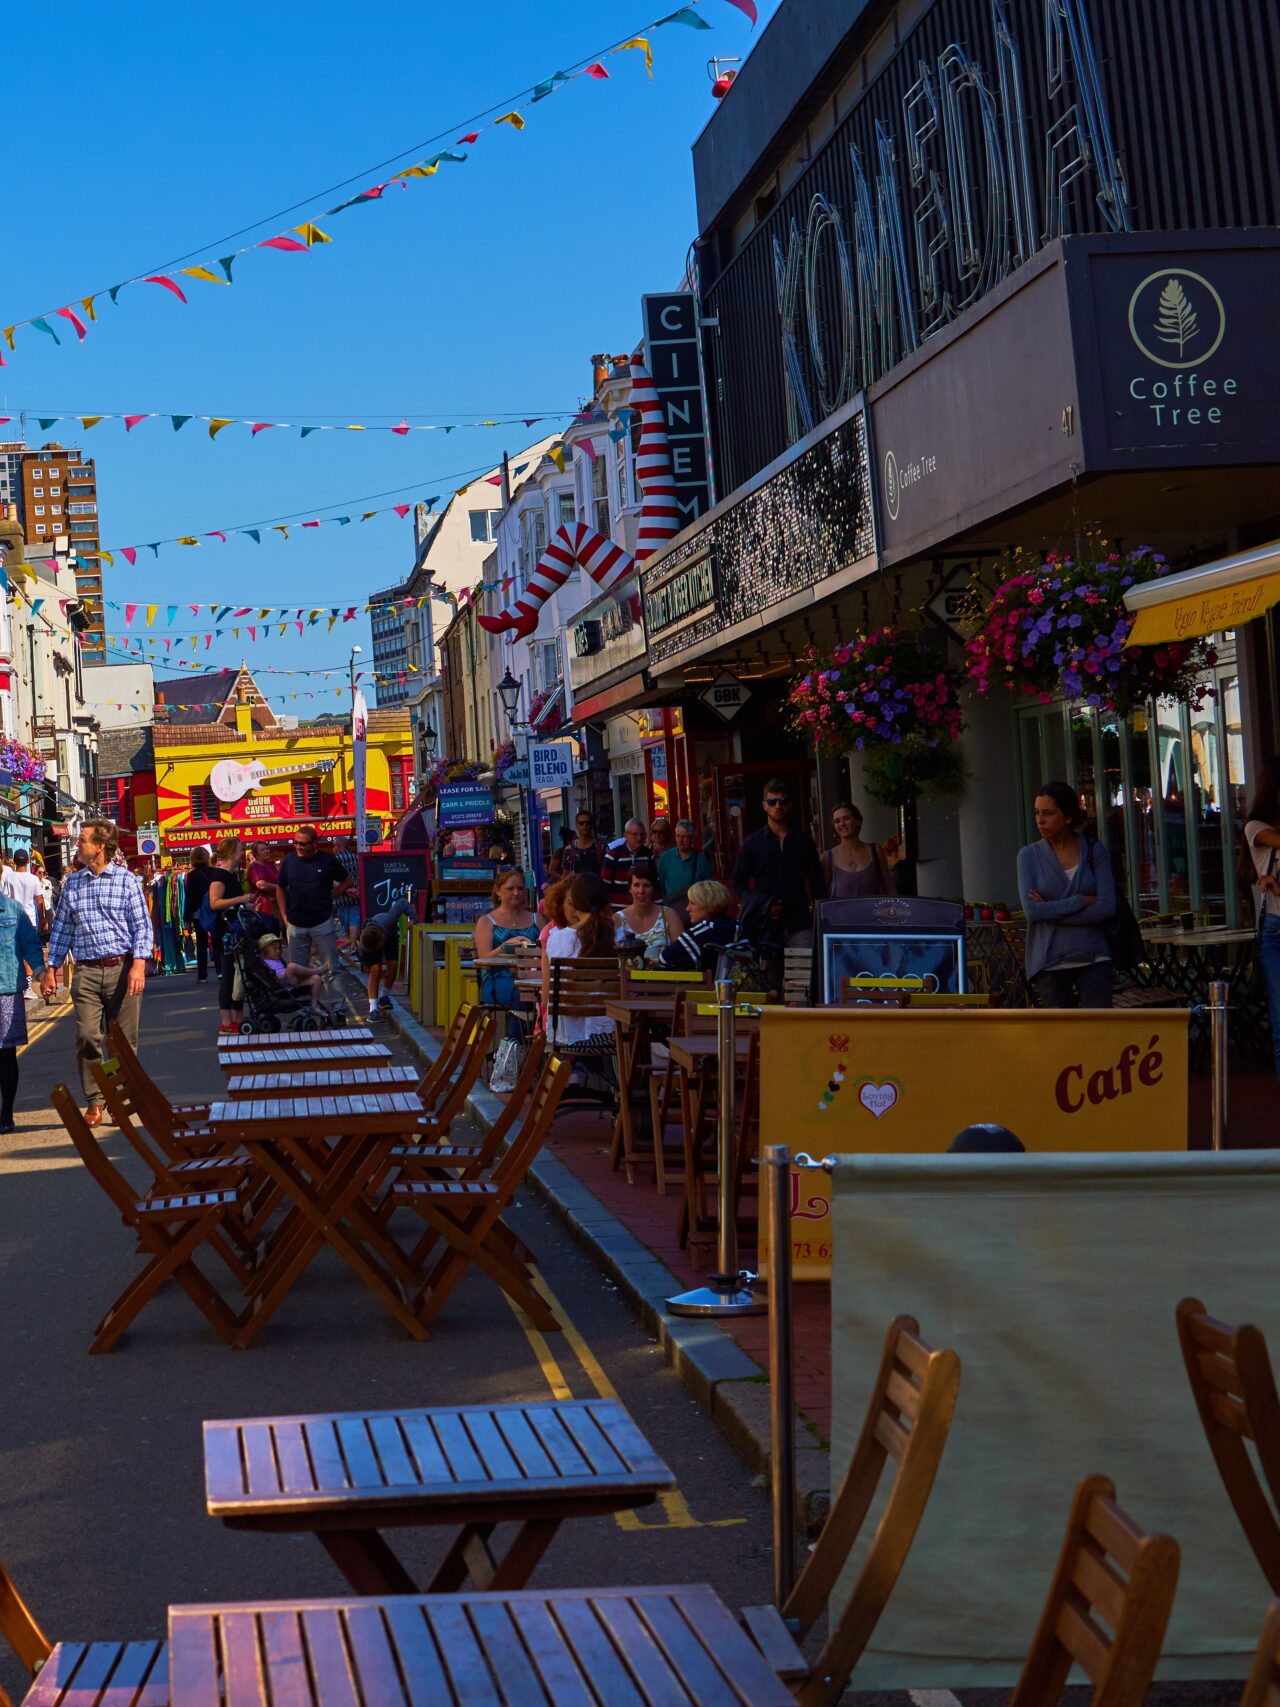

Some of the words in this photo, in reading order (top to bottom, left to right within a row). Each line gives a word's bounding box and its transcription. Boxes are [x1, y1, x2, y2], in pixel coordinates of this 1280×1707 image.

[1130, 374, 1237, 399] Coffee
[660, 305, 699, 521] CINEM
[1061, 405, 1073, 437] 47
[1150, 404, 1221, 426] Tree
[900, 462, 921, 489] Coffee
[922, 455, 937, 477] Tree
[686, 558, 714, 610] KITCHEN
[714, 688, 741, 703] GBK
[533, 749, 557, 762] BIRD
[534, 762, 568, 776] BLEND
[439, 787, 460, 795] LEASE
[245, 804, 275, 815] CAVERN
[168, 831, 212, 842] GUITAR,
[215, 829, 241, 838] AMP
[245, 828, 253, 836] &
[1055, 1034, 1163, 1114] Café
[862, 1091, 895, 1102] Loving
